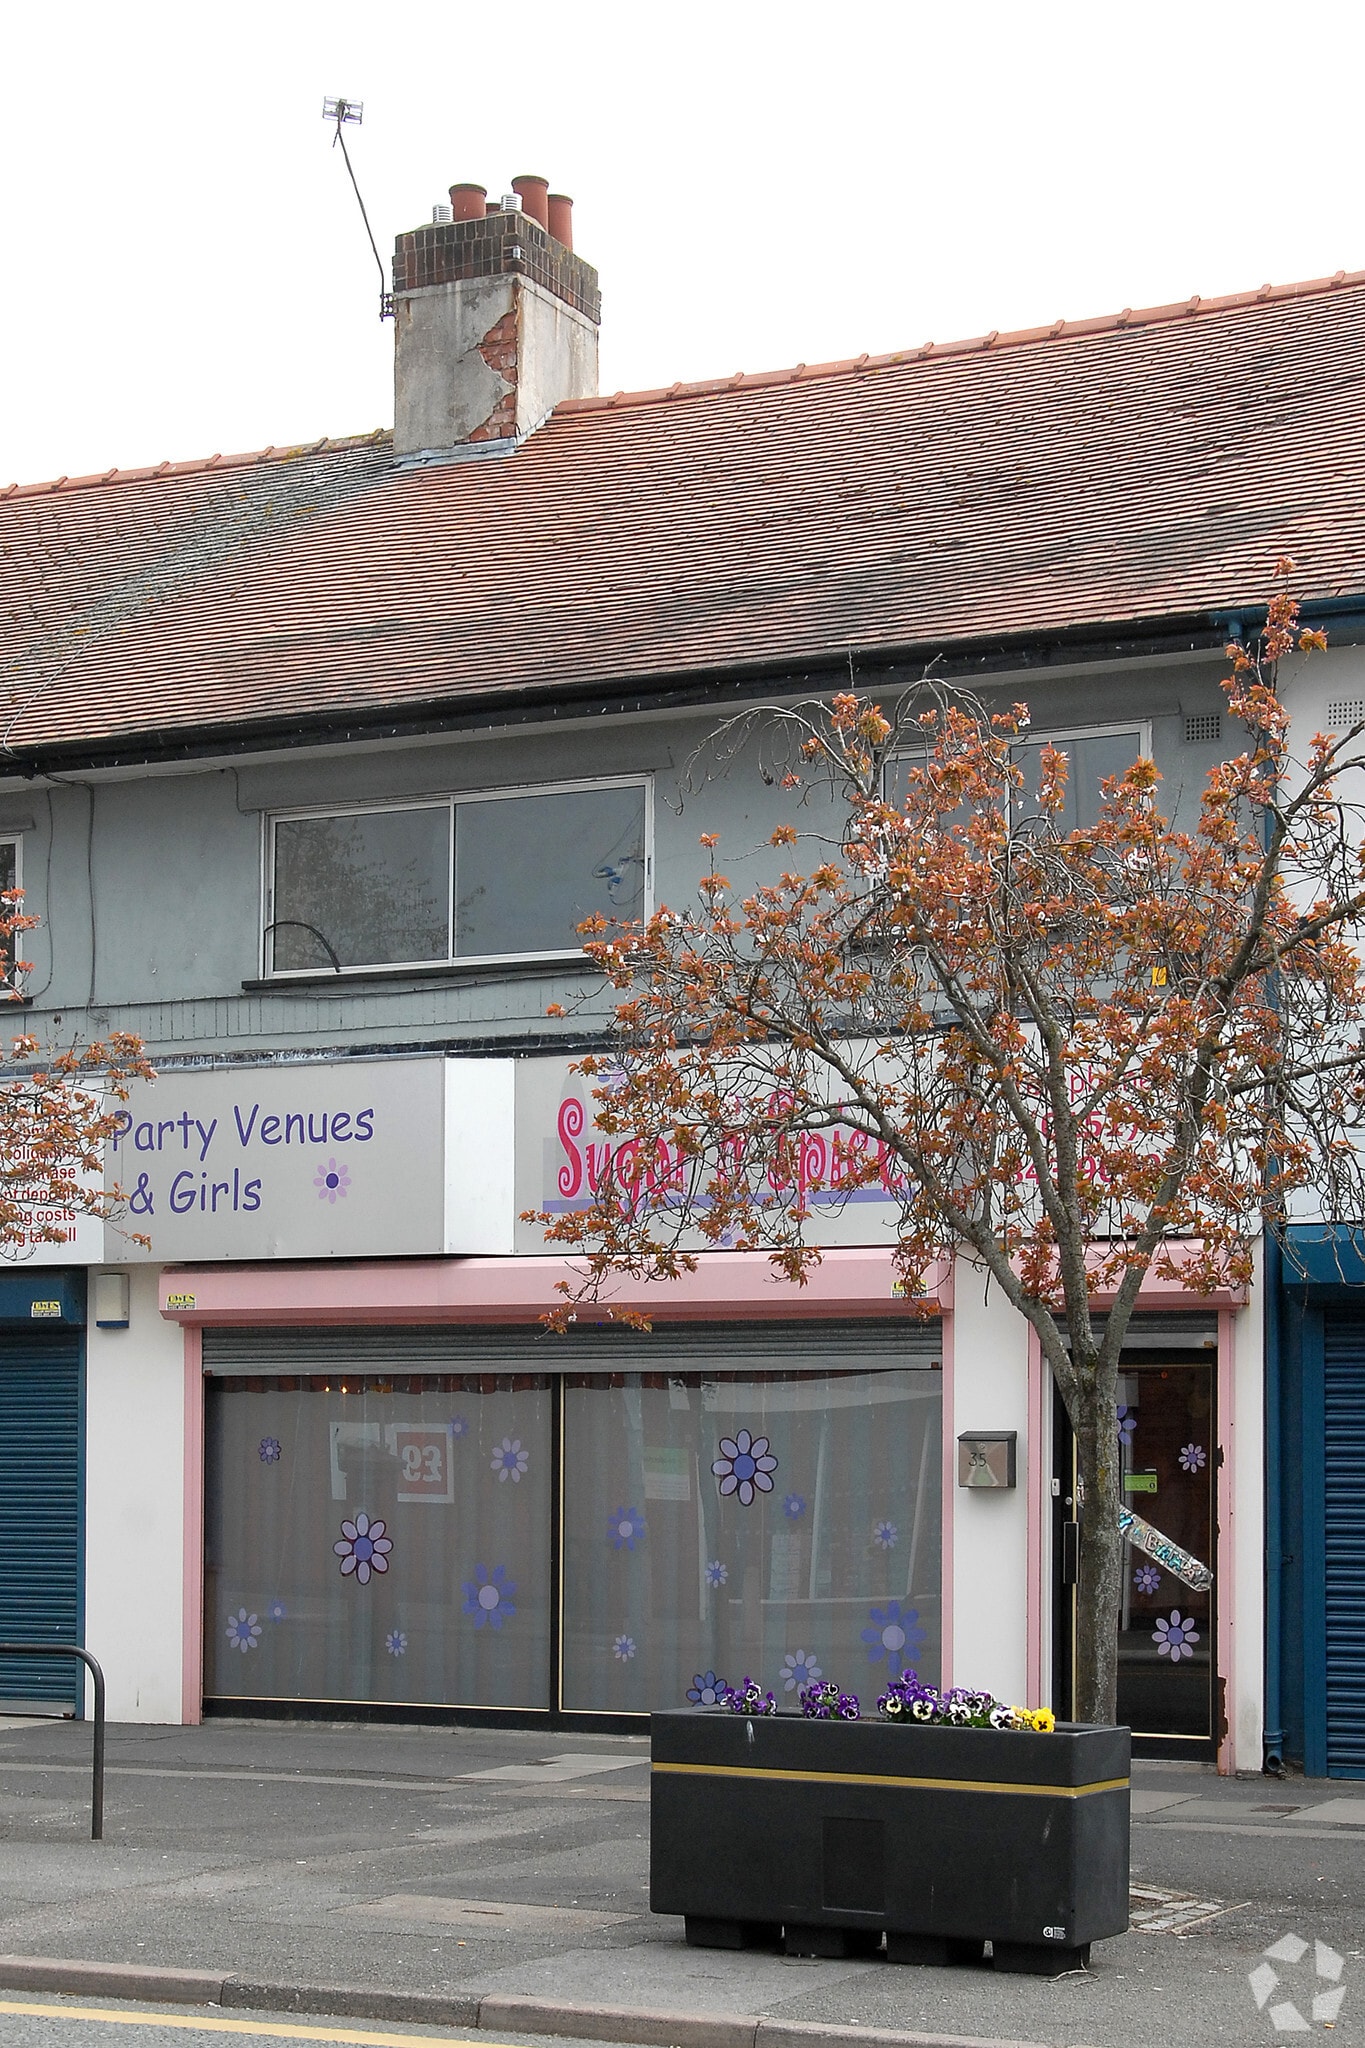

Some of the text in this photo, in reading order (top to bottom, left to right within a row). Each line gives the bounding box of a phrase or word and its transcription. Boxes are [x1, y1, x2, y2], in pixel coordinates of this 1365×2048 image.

[113, 1103, 375, 1161] Party Venues
[129, 1167, 262, 1216] & Girls
[36, 1207, 77, 1222] costs
[968, 1452, 987, 1467] 35
